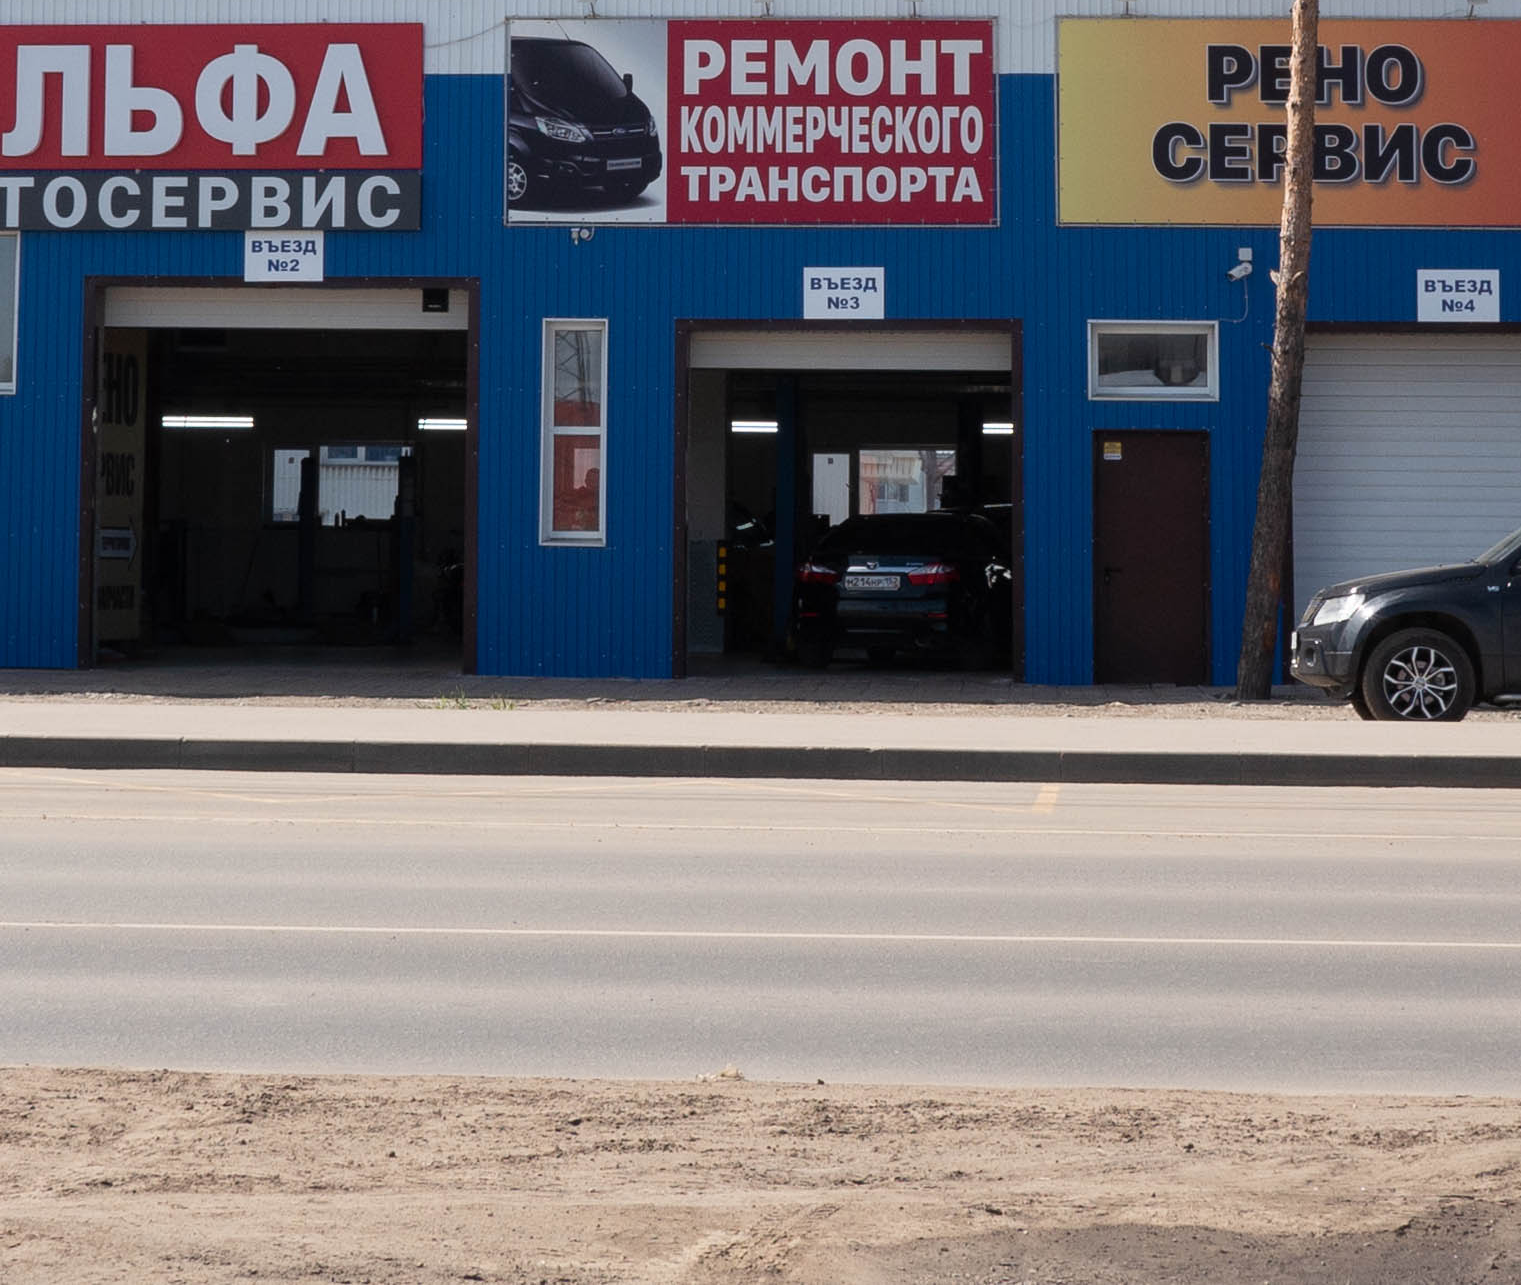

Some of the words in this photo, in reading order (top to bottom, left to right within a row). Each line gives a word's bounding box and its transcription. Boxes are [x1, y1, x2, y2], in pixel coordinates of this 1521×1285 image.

[682, 39, 984, 96] РЕМОНТ
[1206, 43, 1425, 106] РЕНО
[680, 104, 984, 155] КОММЕРЧЕСКОГО
[1152, 122, 1477, 186] СЕРВИС
[681, 164, 984, 204] ТРАНСПОРТА
[250, 239, 317, 256] ВЪЕЗД
[266, 258, 300, 273] №2
[810, 277, 878, 295] ВЪЕЗД
[1423, 279, 1493, 298] ВЪЕЗД
[826, 296, 861, 311] №3
[1440, 299, 1476, 314] №4
